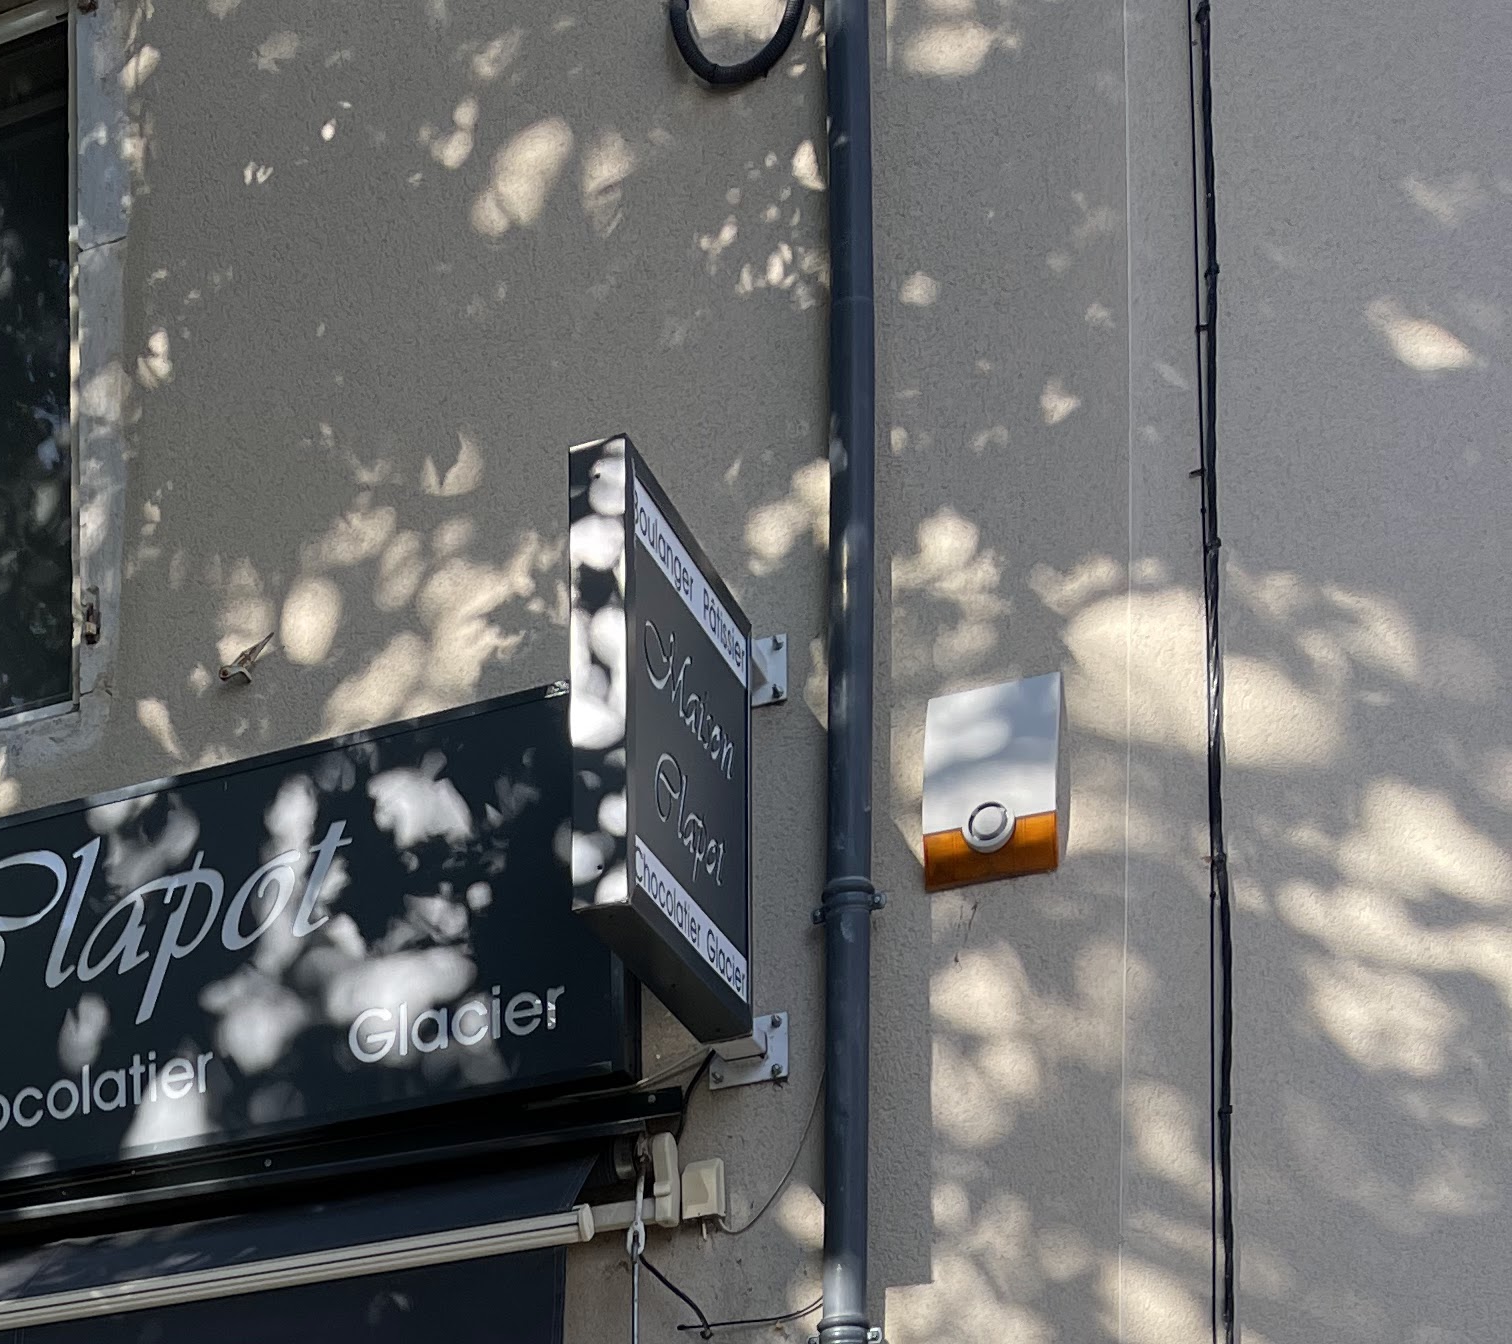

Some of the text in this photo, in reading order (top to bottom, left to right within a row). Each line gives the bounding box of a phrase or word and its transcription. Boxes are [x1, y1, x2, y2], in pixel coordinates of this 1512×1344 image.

[702, 587, 745, 673] Pâtissier
[643, 619, 734, 780] Maison
[654, 752, 726, 887] Clapot
[706, 928, 746, 997] Glacier
[348, 983, 566, 1064] Glacier
